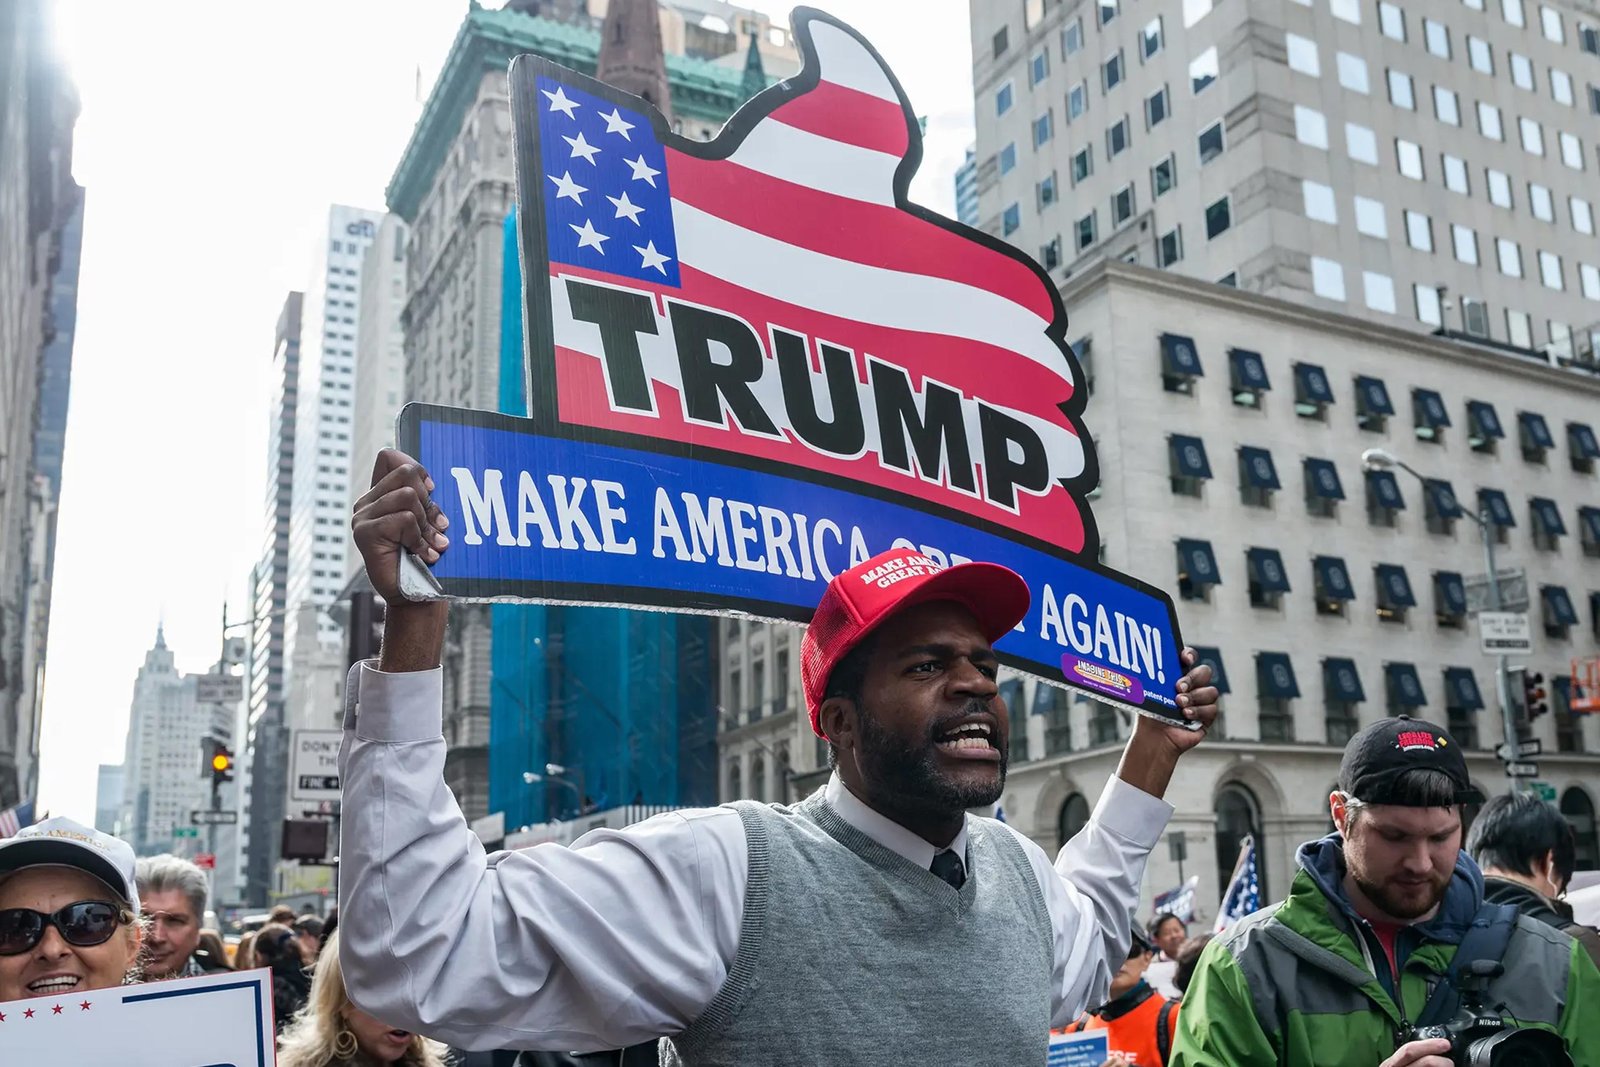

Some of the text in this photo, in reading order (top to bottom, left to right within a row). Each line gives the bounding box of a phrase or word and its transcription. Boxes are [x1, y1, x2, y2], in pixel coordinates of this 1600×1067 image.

[559, 274, 1060, 515] TRUMP
[451, 467, 1165, 684] MAKE AMERICA AGAIN!
[860, 558, 907, 585] MAKE
[877, 566, 926, 588] GREAT
[1077, 660, 1106, 678] IMAGINE
[1143, 690, 1163, 701] patent
[319, 755, 338, 767] TH
